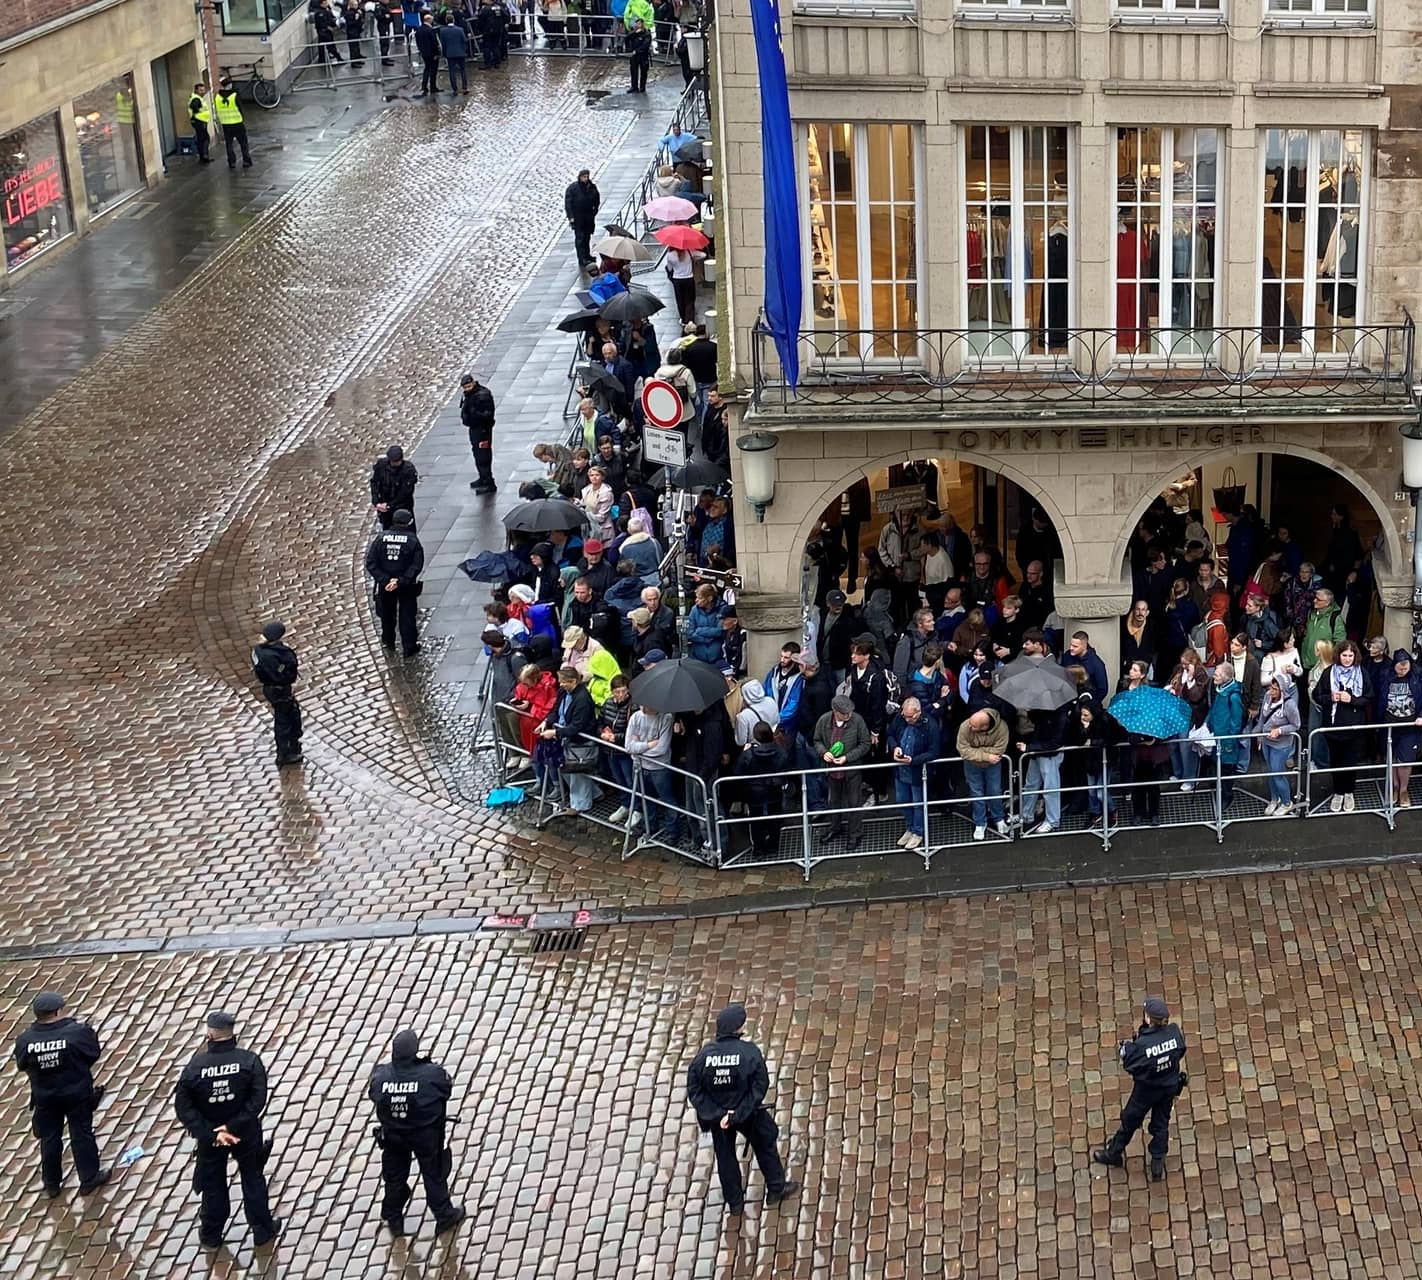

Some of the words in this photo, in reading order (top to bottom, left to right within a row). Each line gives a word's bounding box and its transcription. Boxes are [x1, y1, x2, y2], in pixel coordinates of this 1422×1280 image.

[6, 172, 63, 225] LIEBE
[933, 429, 1068, 450] TOMMY
[1120, 425, 1265, 449] HILFIGER
[383, 535, 408, 543] POLIZEI
[27, 1039, 67, 1054] POLIZEI
[1145, 1038, 1178, 1059] POLIZEI
[37, 1051, 60, 1062] NRW
[705, 1054, 740, 1067] POLIZEI
[200, 1062, 240, 1079] POLIZEI
[381, 1081, 418, 1093] POLIZEI
[713, 1075, 731, 1085] 2641
